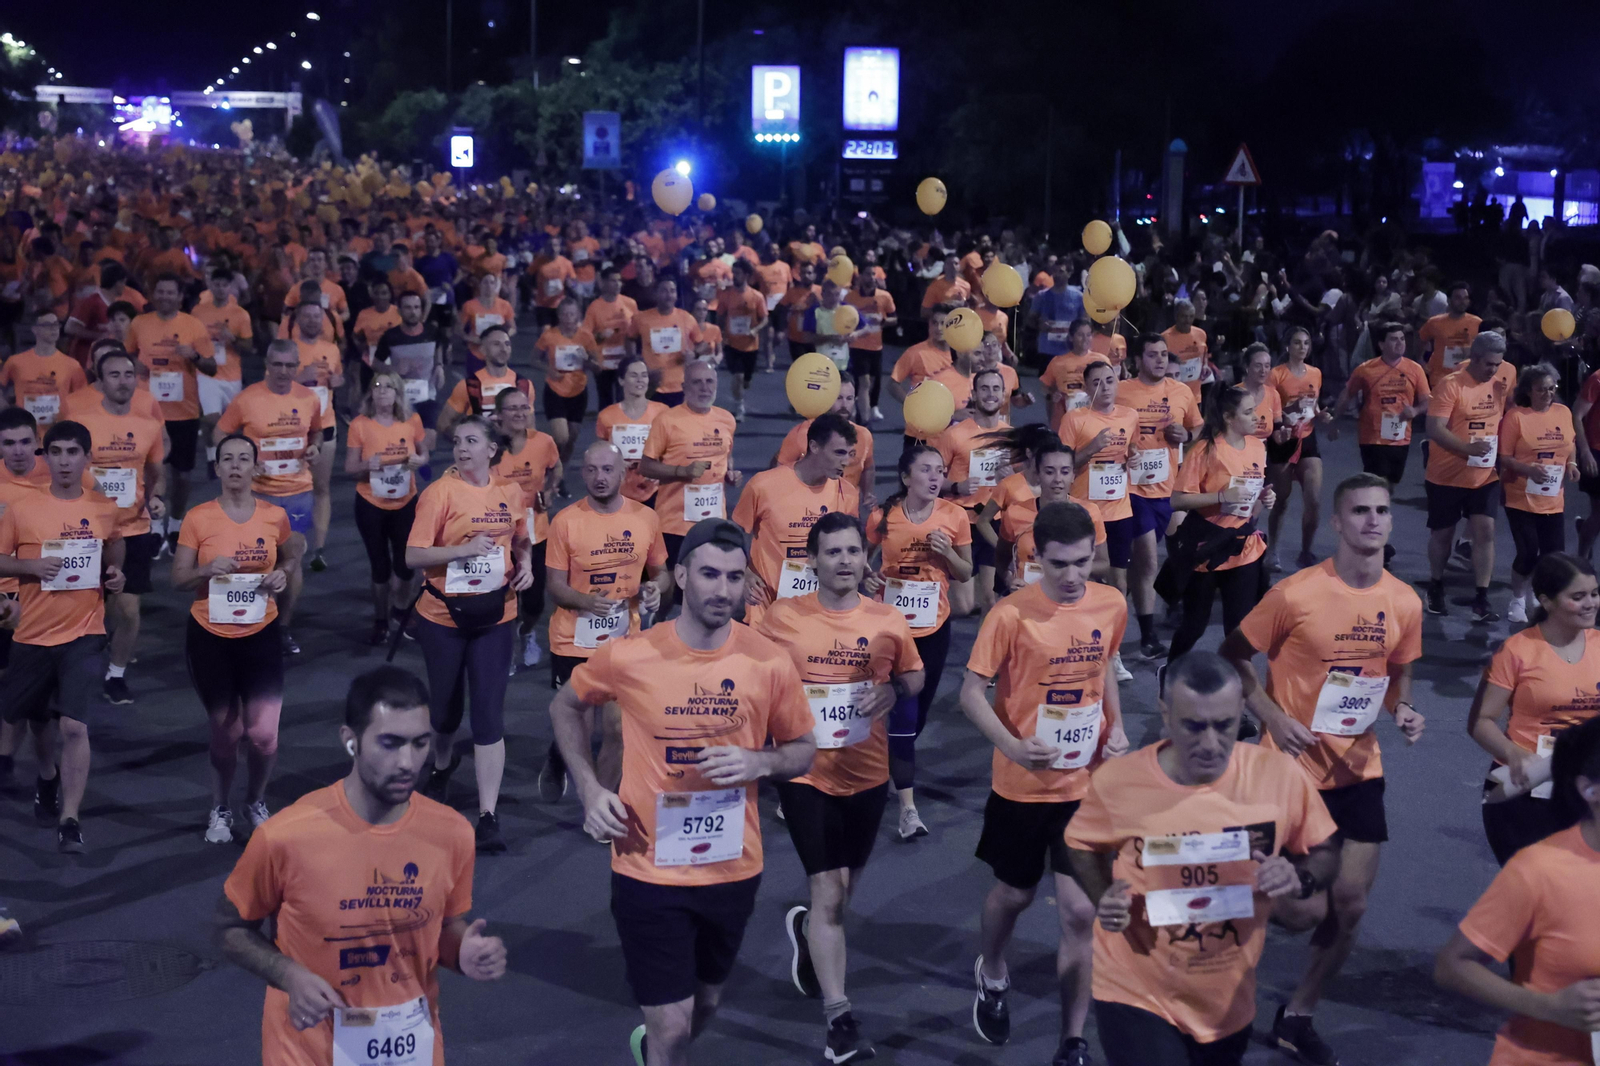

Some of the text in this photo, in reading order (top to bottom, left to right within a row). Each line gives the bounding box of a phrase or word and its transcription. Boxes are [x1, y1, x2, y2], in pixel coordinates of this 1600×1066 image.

[764, 71, 792, 110] P
[845, 141, 894, 155] 22:03
[621, 436, 646, 444] 20815
[1139, 460, 1163, 470] 18585
[1099, 475, 1123, 485] 13553
[694, 496, 718, 506] 20122
[251, 554, 268, 562] KH7
[590, 548, 617, 556] SEVILLA
[63, 556, 92, 568] 8637
[463, 562, 491, 574] 6073
[791, 578, 818, 591] 2011
[226, 590, 256, 603] 6069
[895, 595, 930, 609] 20115
[588, 616, 620, 629] 16097
[1334, 633, 1368, 641] SEVILLA
[827, 650, 871, 659] NOCTURNA
[1067, 645, 1104, 654] NOCTURNA
[807, 655, 870, 668] SEVILLA KH7
[1049, 652, 1104, 665] SEVILLA KH7
[687, 697, 739, 706] NOCTURNA
[1338, 696, 1371, 710] 3903
[664, 706, 738, 717] SEVILLA KH7
[1054, 725, 1094, 743] 14875
[683, 815, 725, 834] 5792
[1180, 865, 1220, 887] 905
[366, 886, 424, 896] NOCTURNA
[339, 897, 423, 911] SEVILLA KH7
[366, 1033, 416, 1060] 6469
